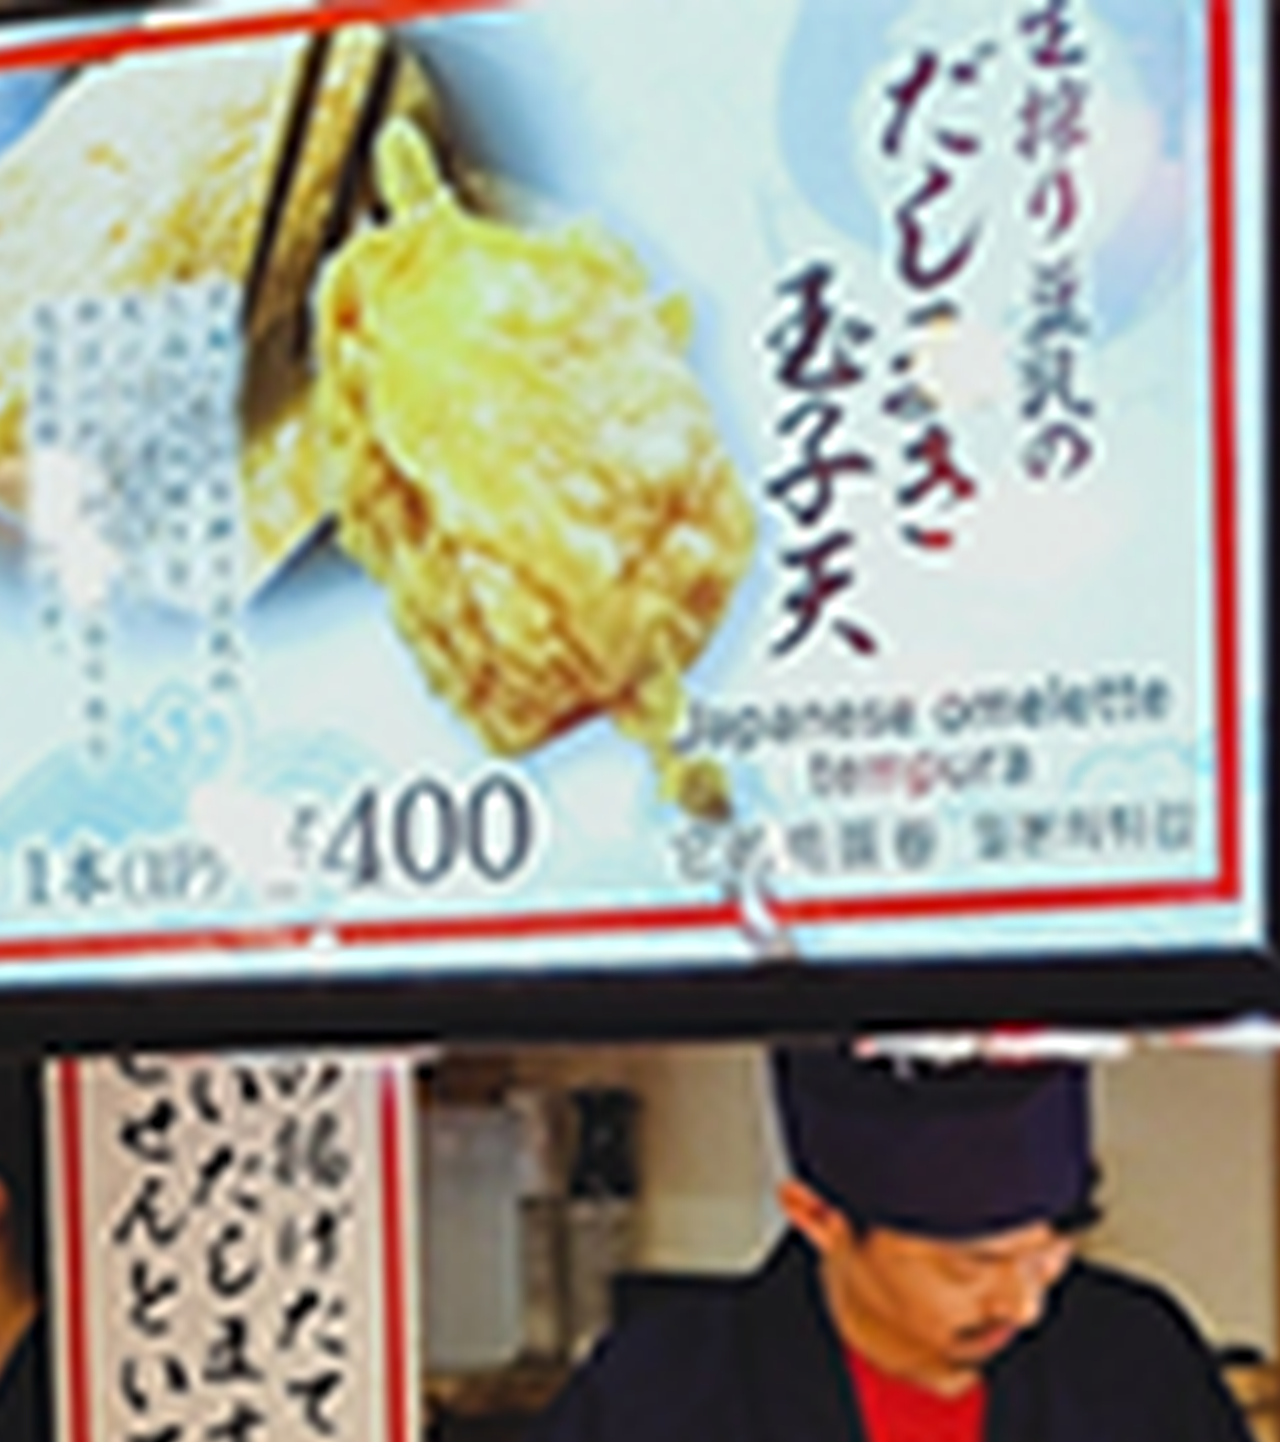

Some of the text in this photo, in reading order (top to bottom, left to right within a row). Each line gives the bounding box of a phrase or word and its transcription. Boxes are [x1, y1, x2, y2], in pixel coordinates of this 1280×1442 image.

[674, 672, 1172, 754] Japanese omelette
[807, 744, 1034, 797] tempura
